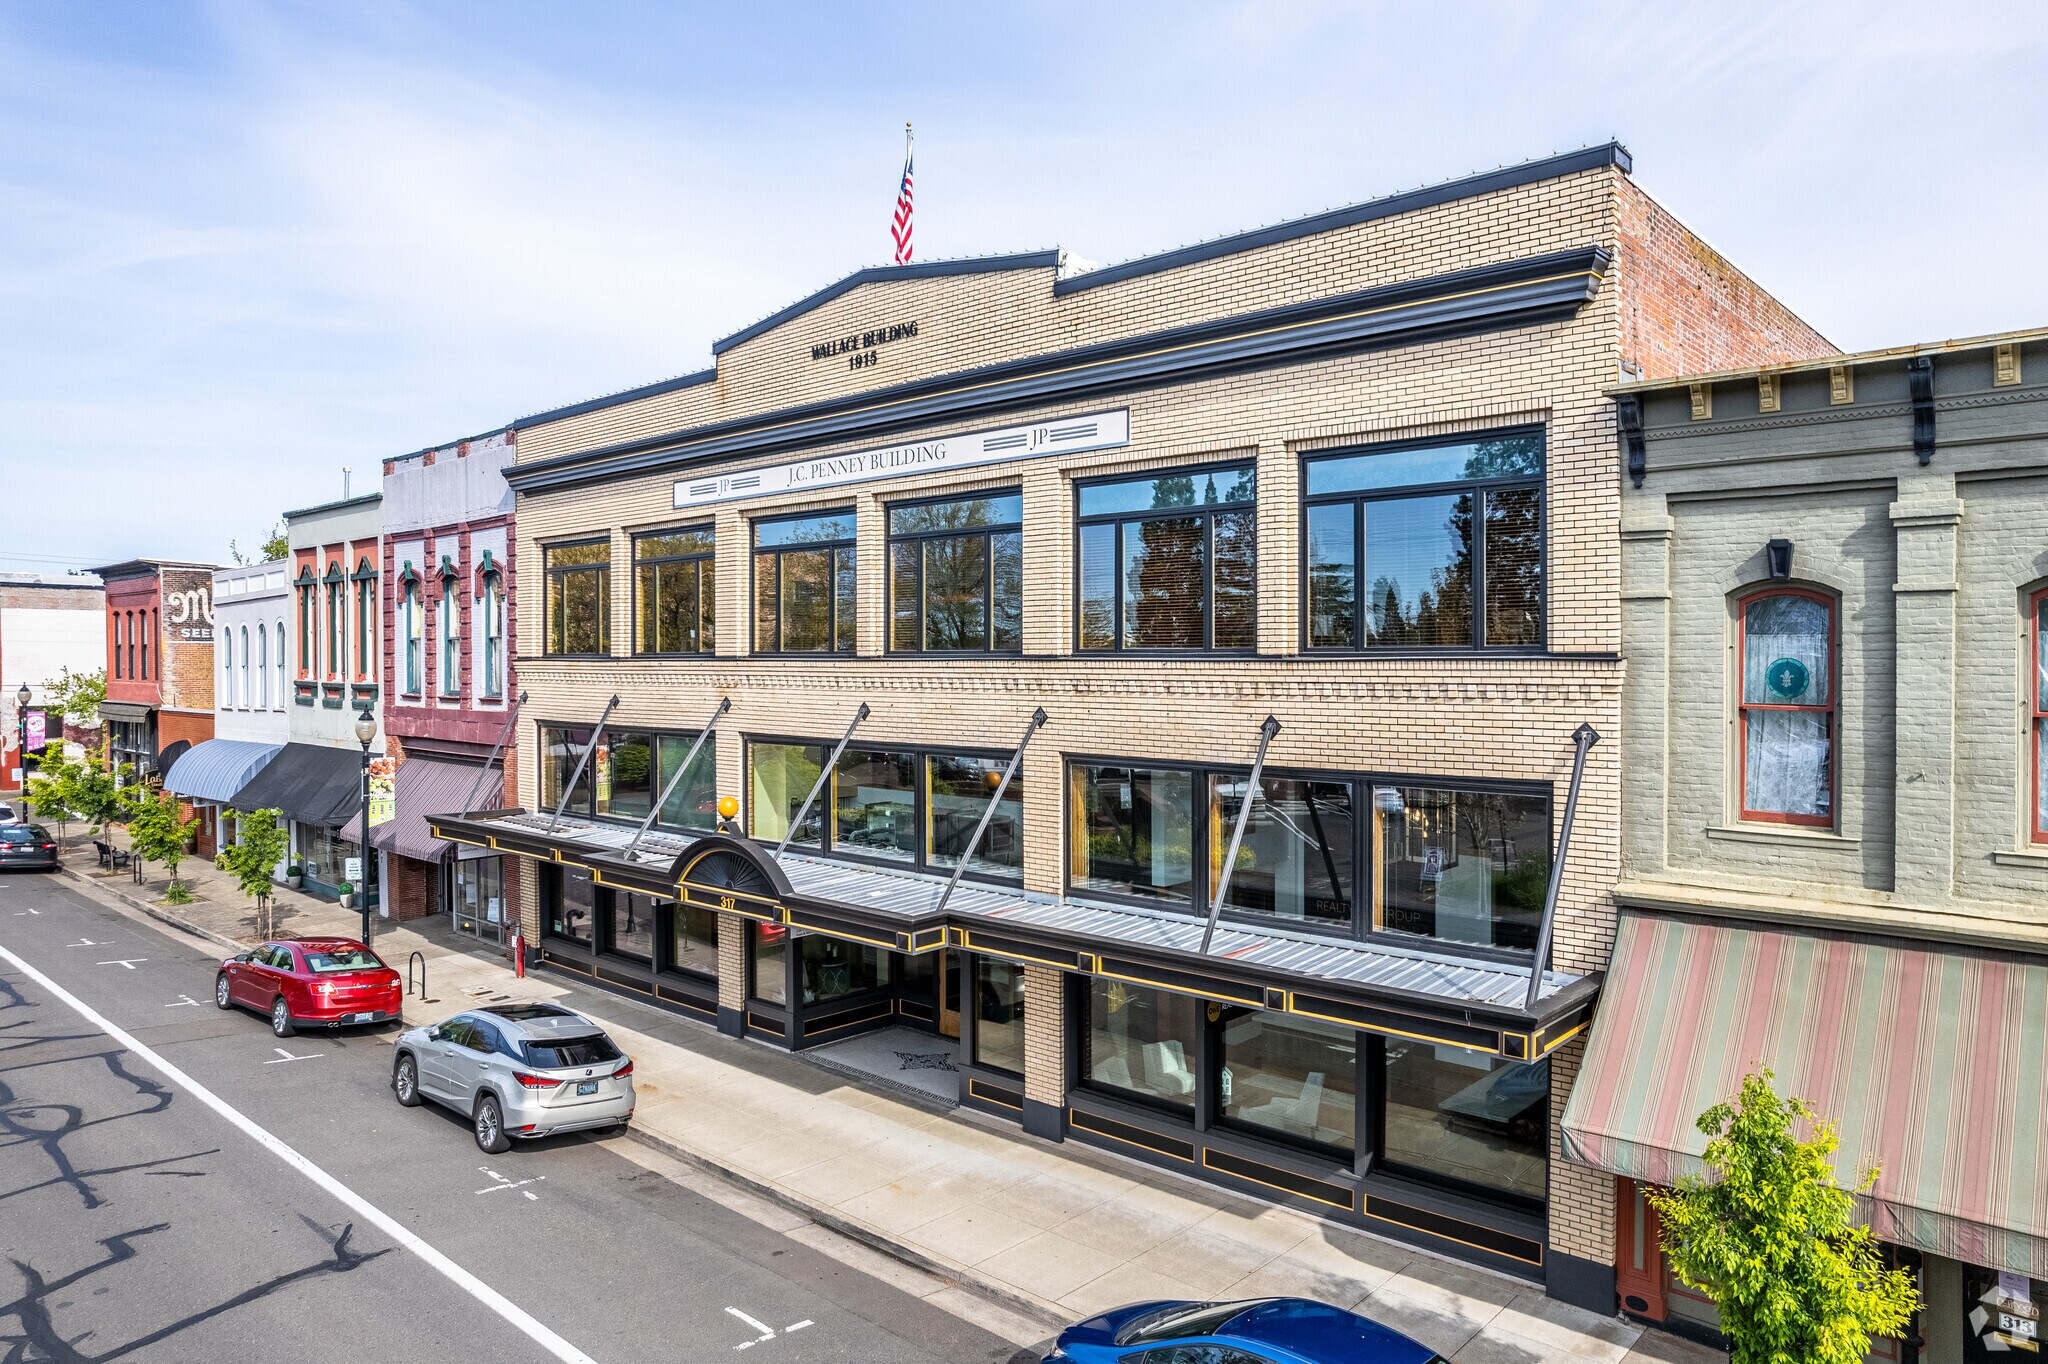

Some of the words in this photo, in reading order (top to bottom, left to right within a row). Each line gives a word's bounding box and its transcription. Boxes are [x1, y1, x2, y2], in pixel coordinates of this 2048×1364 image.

[812, 335, 860, 361] WALLACE
[863, 320, 918, 348] BUILDING
[849, 351, 878, 370] 1915
[1030, 428, 1048, 450] JP
[787, 468, 808, 487] J.C.
[811, 456, 867, 478] PENNEY
[870, 443, 947, 470] BUILDING
[718, 478, 730, 496] JP
[181, 628, 214, 638] SEE
[720, 896, 736, 909] 317
[2003, 1315, 2032, 1333] 313
